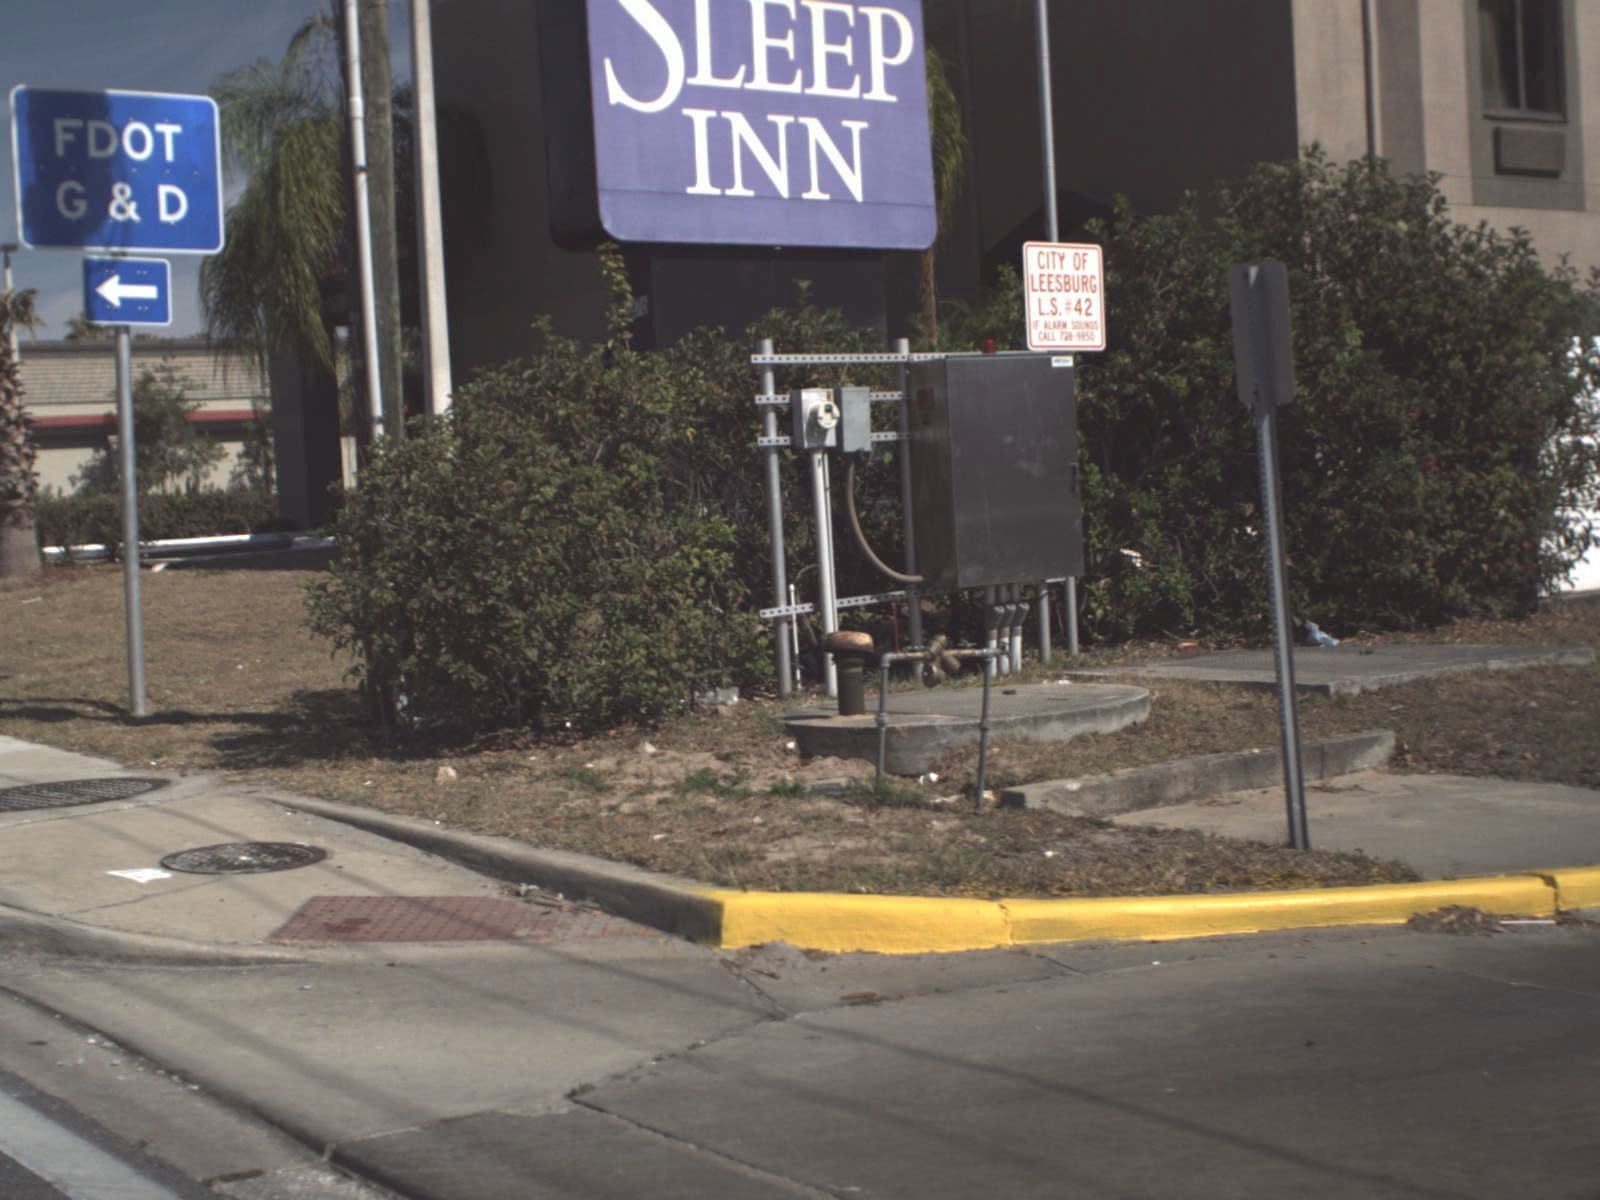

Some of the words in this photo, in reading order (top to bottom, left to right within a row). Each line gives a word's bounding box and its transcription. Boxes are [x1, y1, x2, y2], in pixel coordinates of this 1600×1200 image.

[604, 0, 914, 113] SLEEP
[53, 118, 183, 162] FDOT
[682, 108, 868, 202] INN
[56, 180, 87, 220] G
[108, 182, 141, 222] &
[157, 184, 188, 222] D
[1037, 250, 1066, 270] CITY
[1073, 252, 1089, 271] OF
[1030, 273, 1097, 293] LEESBURG
[1038, 297, 1062, 316] L.S.
[1043, 320, 1067, 330] ALARM
[1037, 330, 1057, 342] CALL
